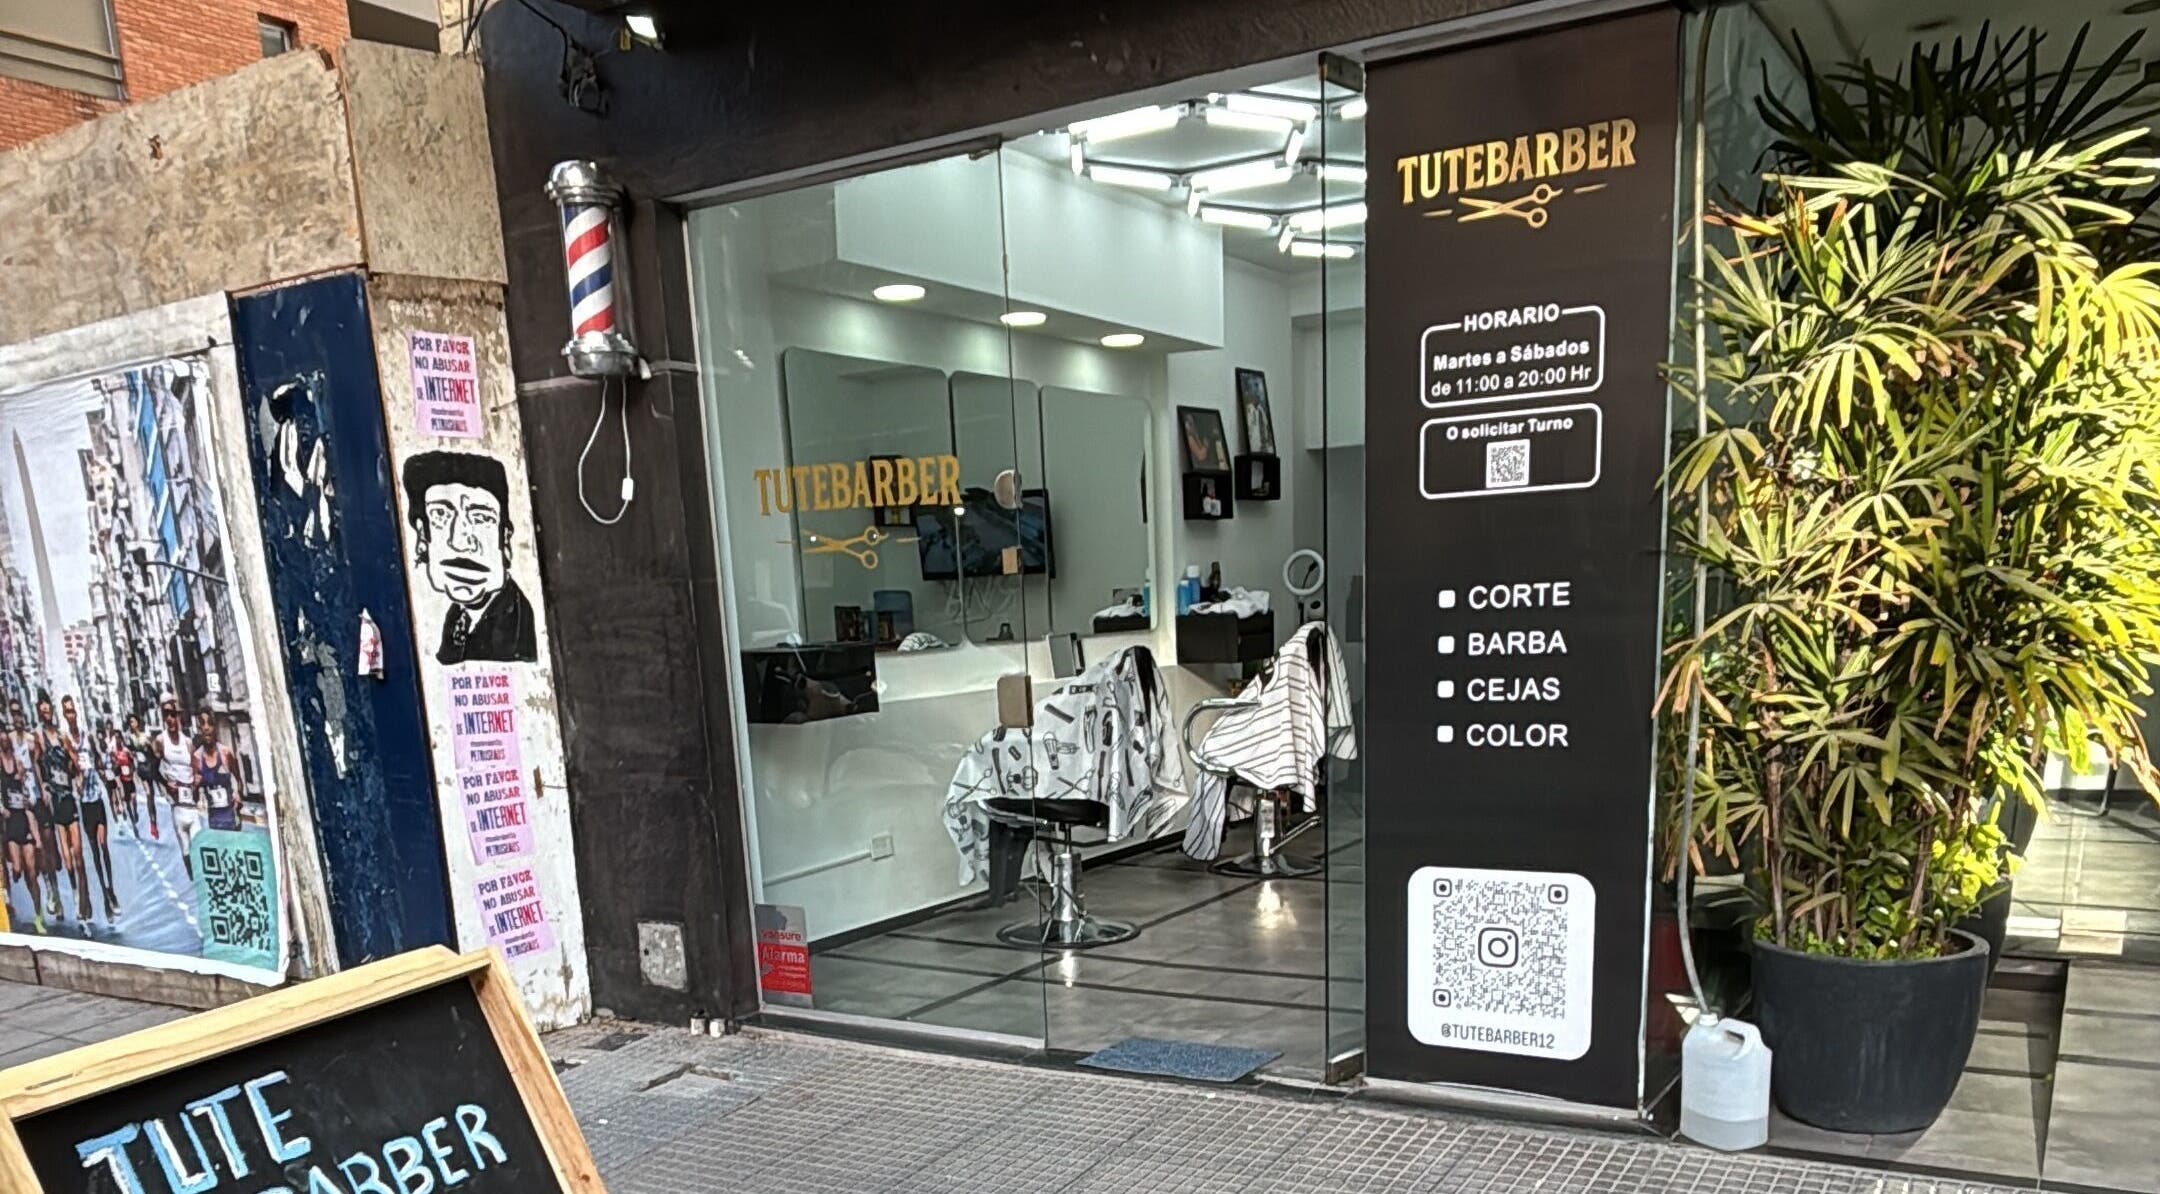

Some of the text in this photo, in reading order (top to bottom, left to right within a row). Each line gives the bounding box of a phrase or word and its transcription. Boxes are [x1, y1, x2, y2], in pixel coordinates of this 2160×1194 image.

[1397, 117, 1637, 204] TUTEBARBER
[1463, 303, 1560, 333] HORARIO
[412, 335, 470, 356] POR FAVOR
[1433, 340, 1590, 371] Martes a Sábados
[415, 356, 471, 373] NO ABUSAR
[424, 375, 476, 404] INTERNET
[1431, 364, 1592, 397] de 11:00 a 20:00 Hr
[1446, 417, 1574, 441] O solicitar Turno
[754, 454, 963, 516] TUTEBARBER
[1468, 581, 1571, 609] CORTE
[1467, 630, 1568, 656] BARBA
[452, 675, 509, 689] POR FAVOR
[1467, 677, 1560, 701] CEJAS
[454, 693, 509, 707] NO ABUSAR
[463, 709, 514, 735] INTERNET
[1466, 723, 1569, 747] COLOR
[463, 769, 519, 789] POR FAVOR
[466, 786, 520, 805] NO ABUSAR
[476, 802, 526, 831] INTERNET
[478, 870, 533, 895] POR FAVOR
[483, 886, 535, 911] NO ABUSAR
[494, 900, 544, 934] INTERNET
[1441, 1023, 1555, 1049] @TUTEBARBER12
[75, 1070, 311, 1194] TUTE
